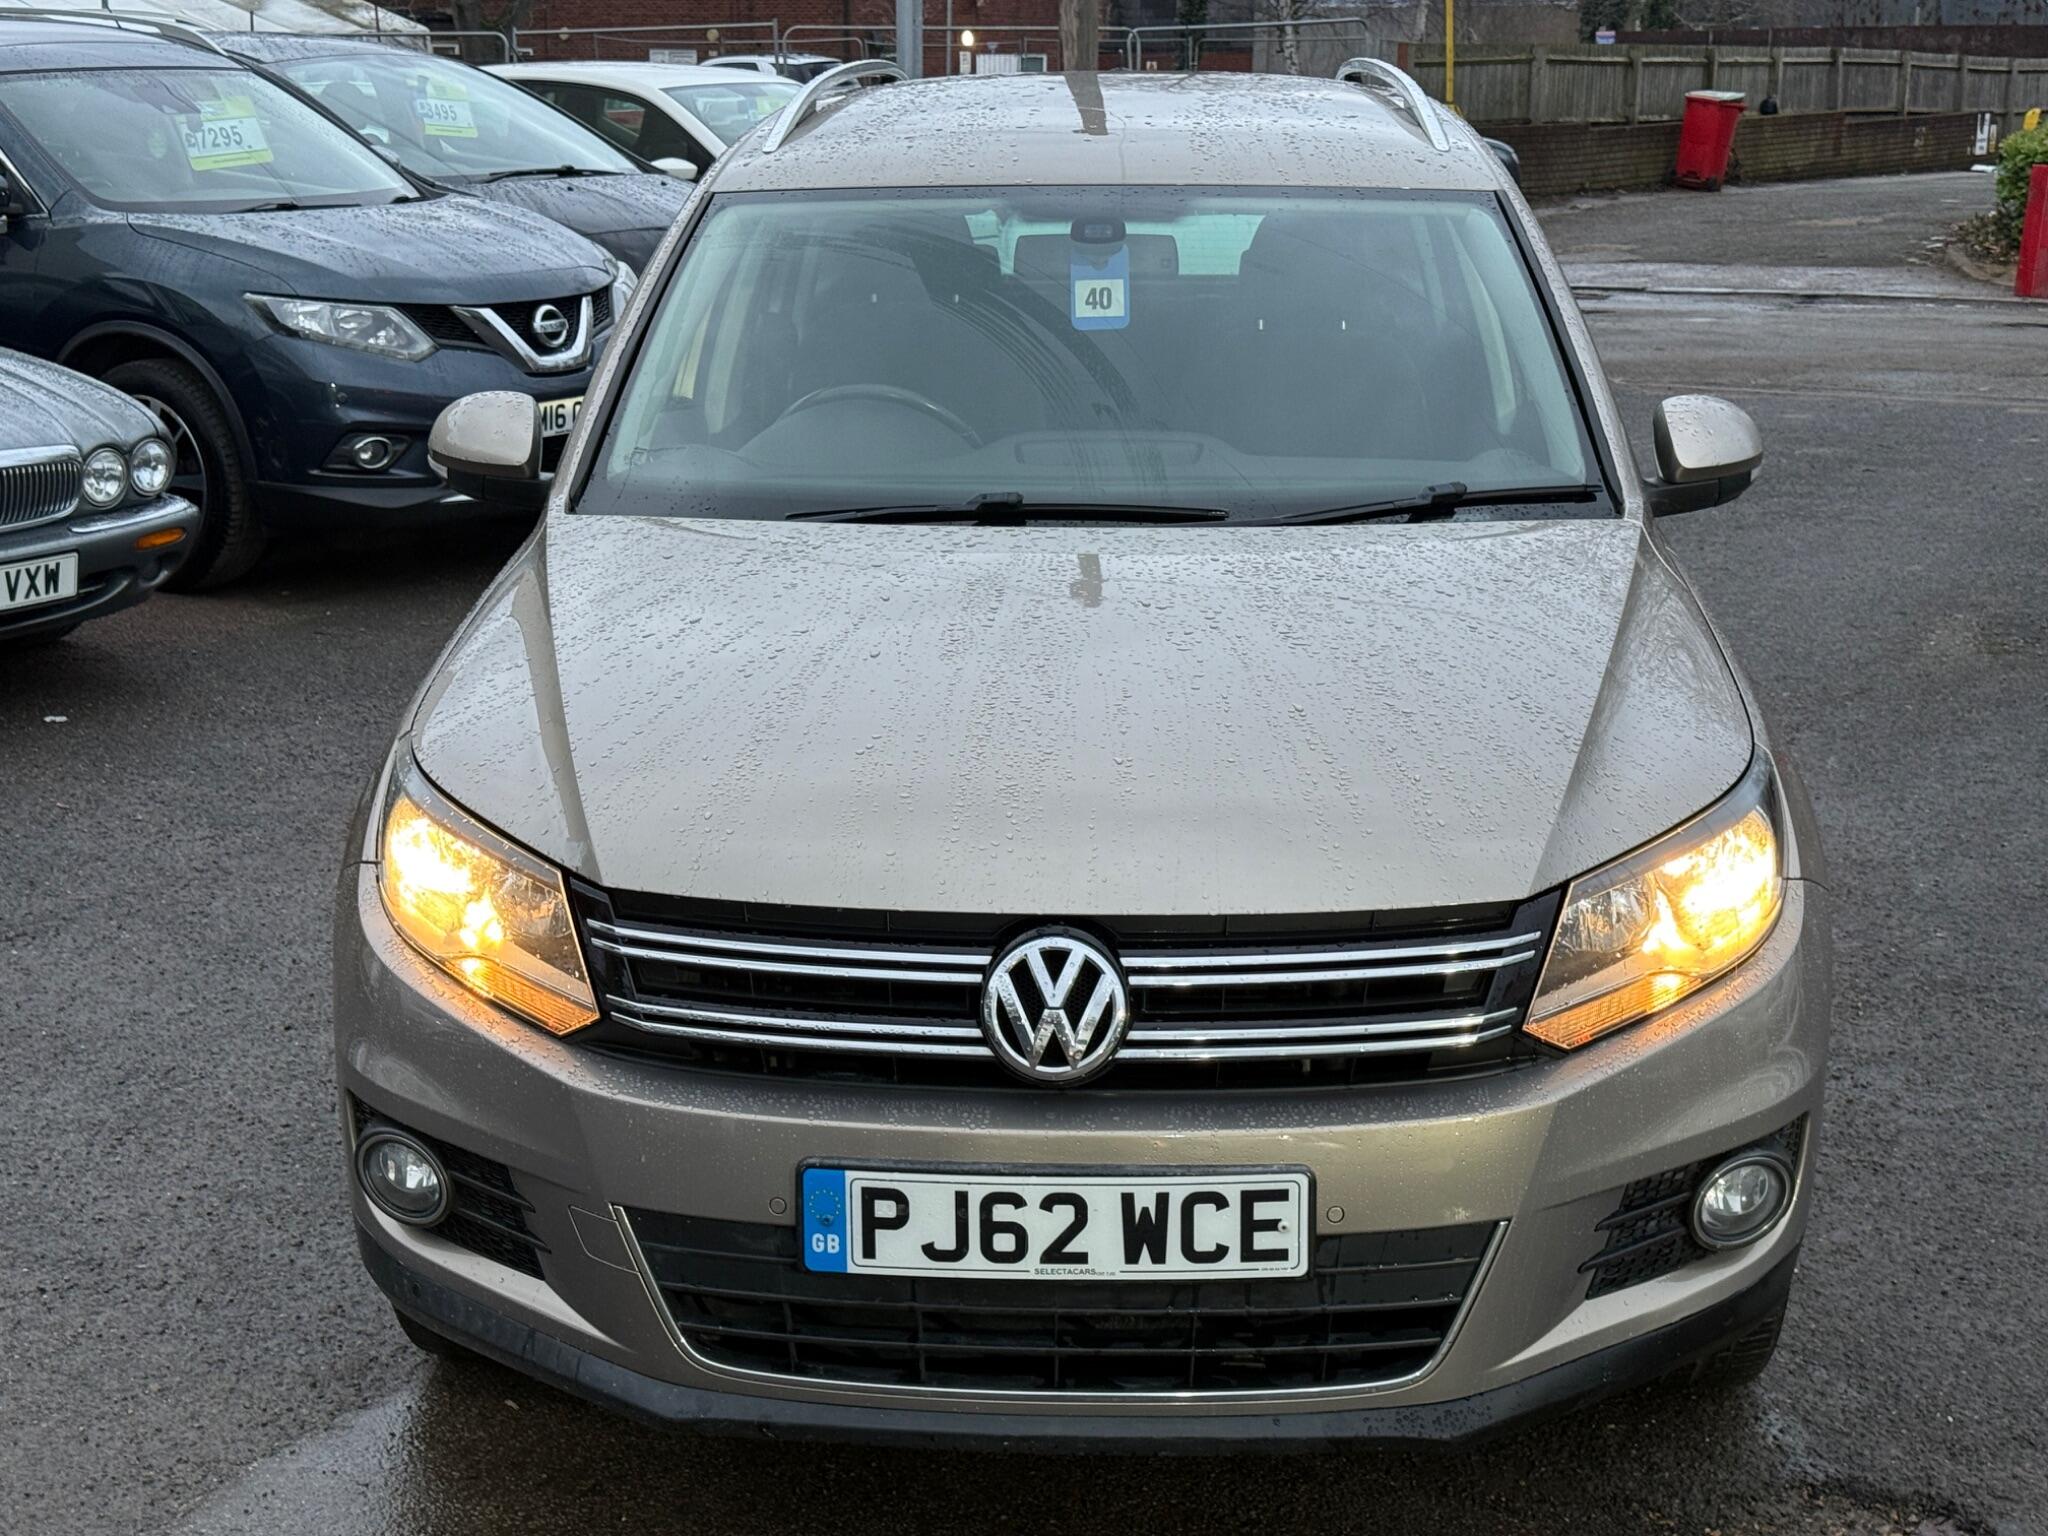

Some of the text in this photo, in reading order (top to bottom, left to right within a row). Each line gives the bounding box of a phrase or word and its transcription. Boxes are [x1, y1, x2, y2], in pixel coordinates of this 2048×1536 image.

[1085, 287, 1112, 310] 40
[4, 562, 60, 602] VXW
[861, 1186, 1290, 1265] PJ62 WCE
[812, 1233, 840, 1254] GB
[1034, 1267, 1096, 1275] SELECTACARS
